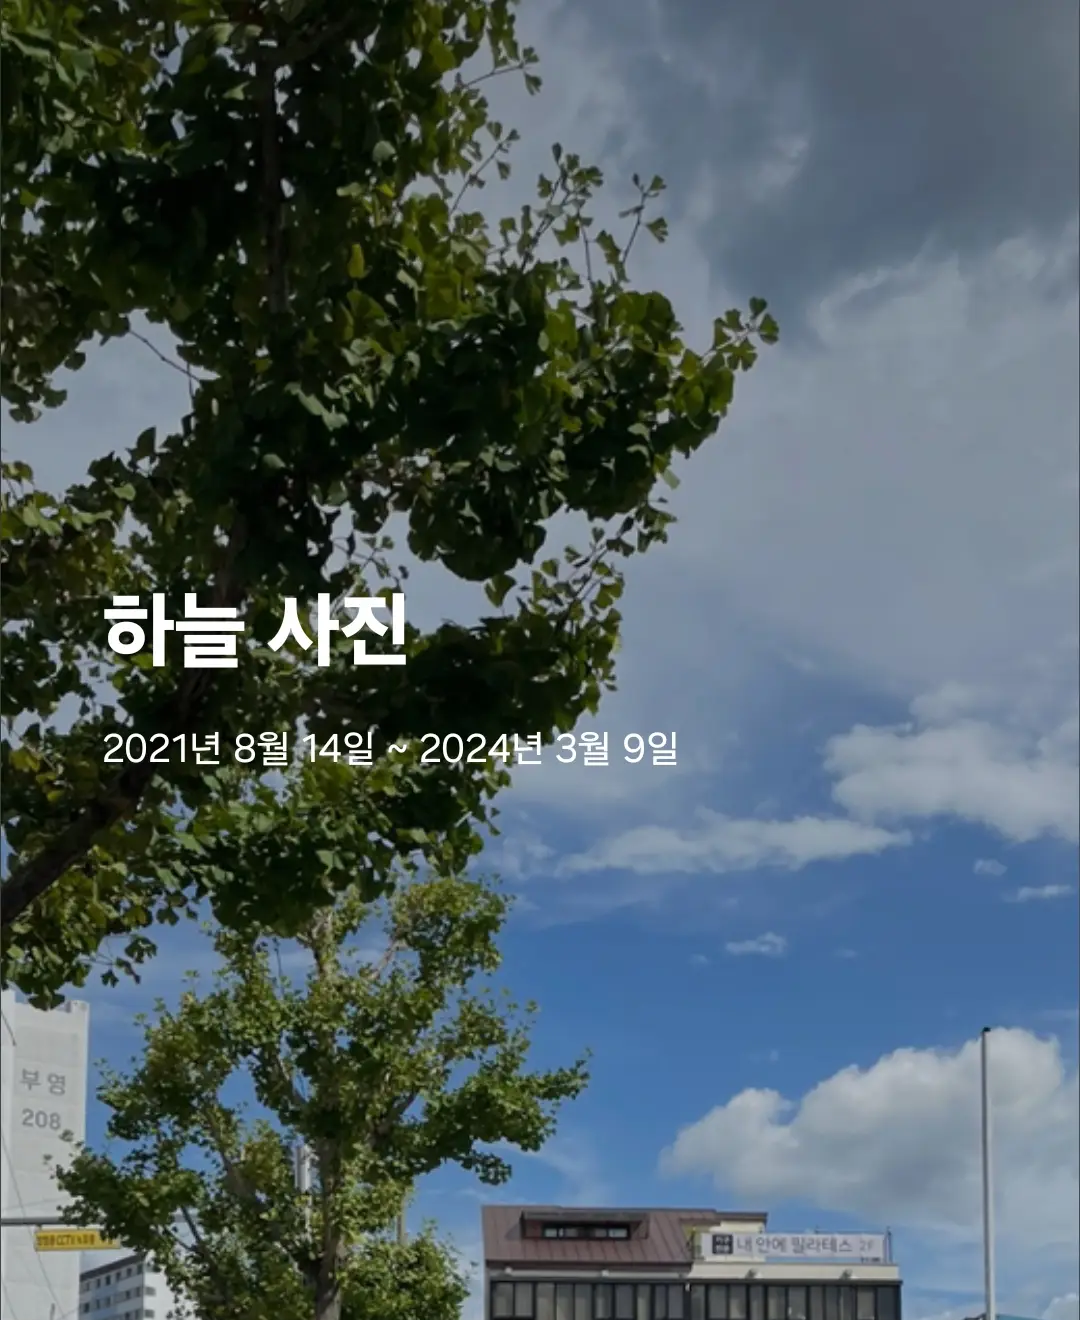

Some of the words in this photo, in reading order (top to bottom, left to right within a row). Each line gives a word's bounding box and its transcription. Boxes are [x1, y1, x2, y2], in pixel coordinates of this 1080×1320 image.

[20, 1068, 66, 1095] 부영
[22, 1108, 61, 1131] 208
[737, 1235, 752, 1253] 내
[756, 1235, 787, 1254] 안에
[791, 1235, 852, 1254] 필라테스
